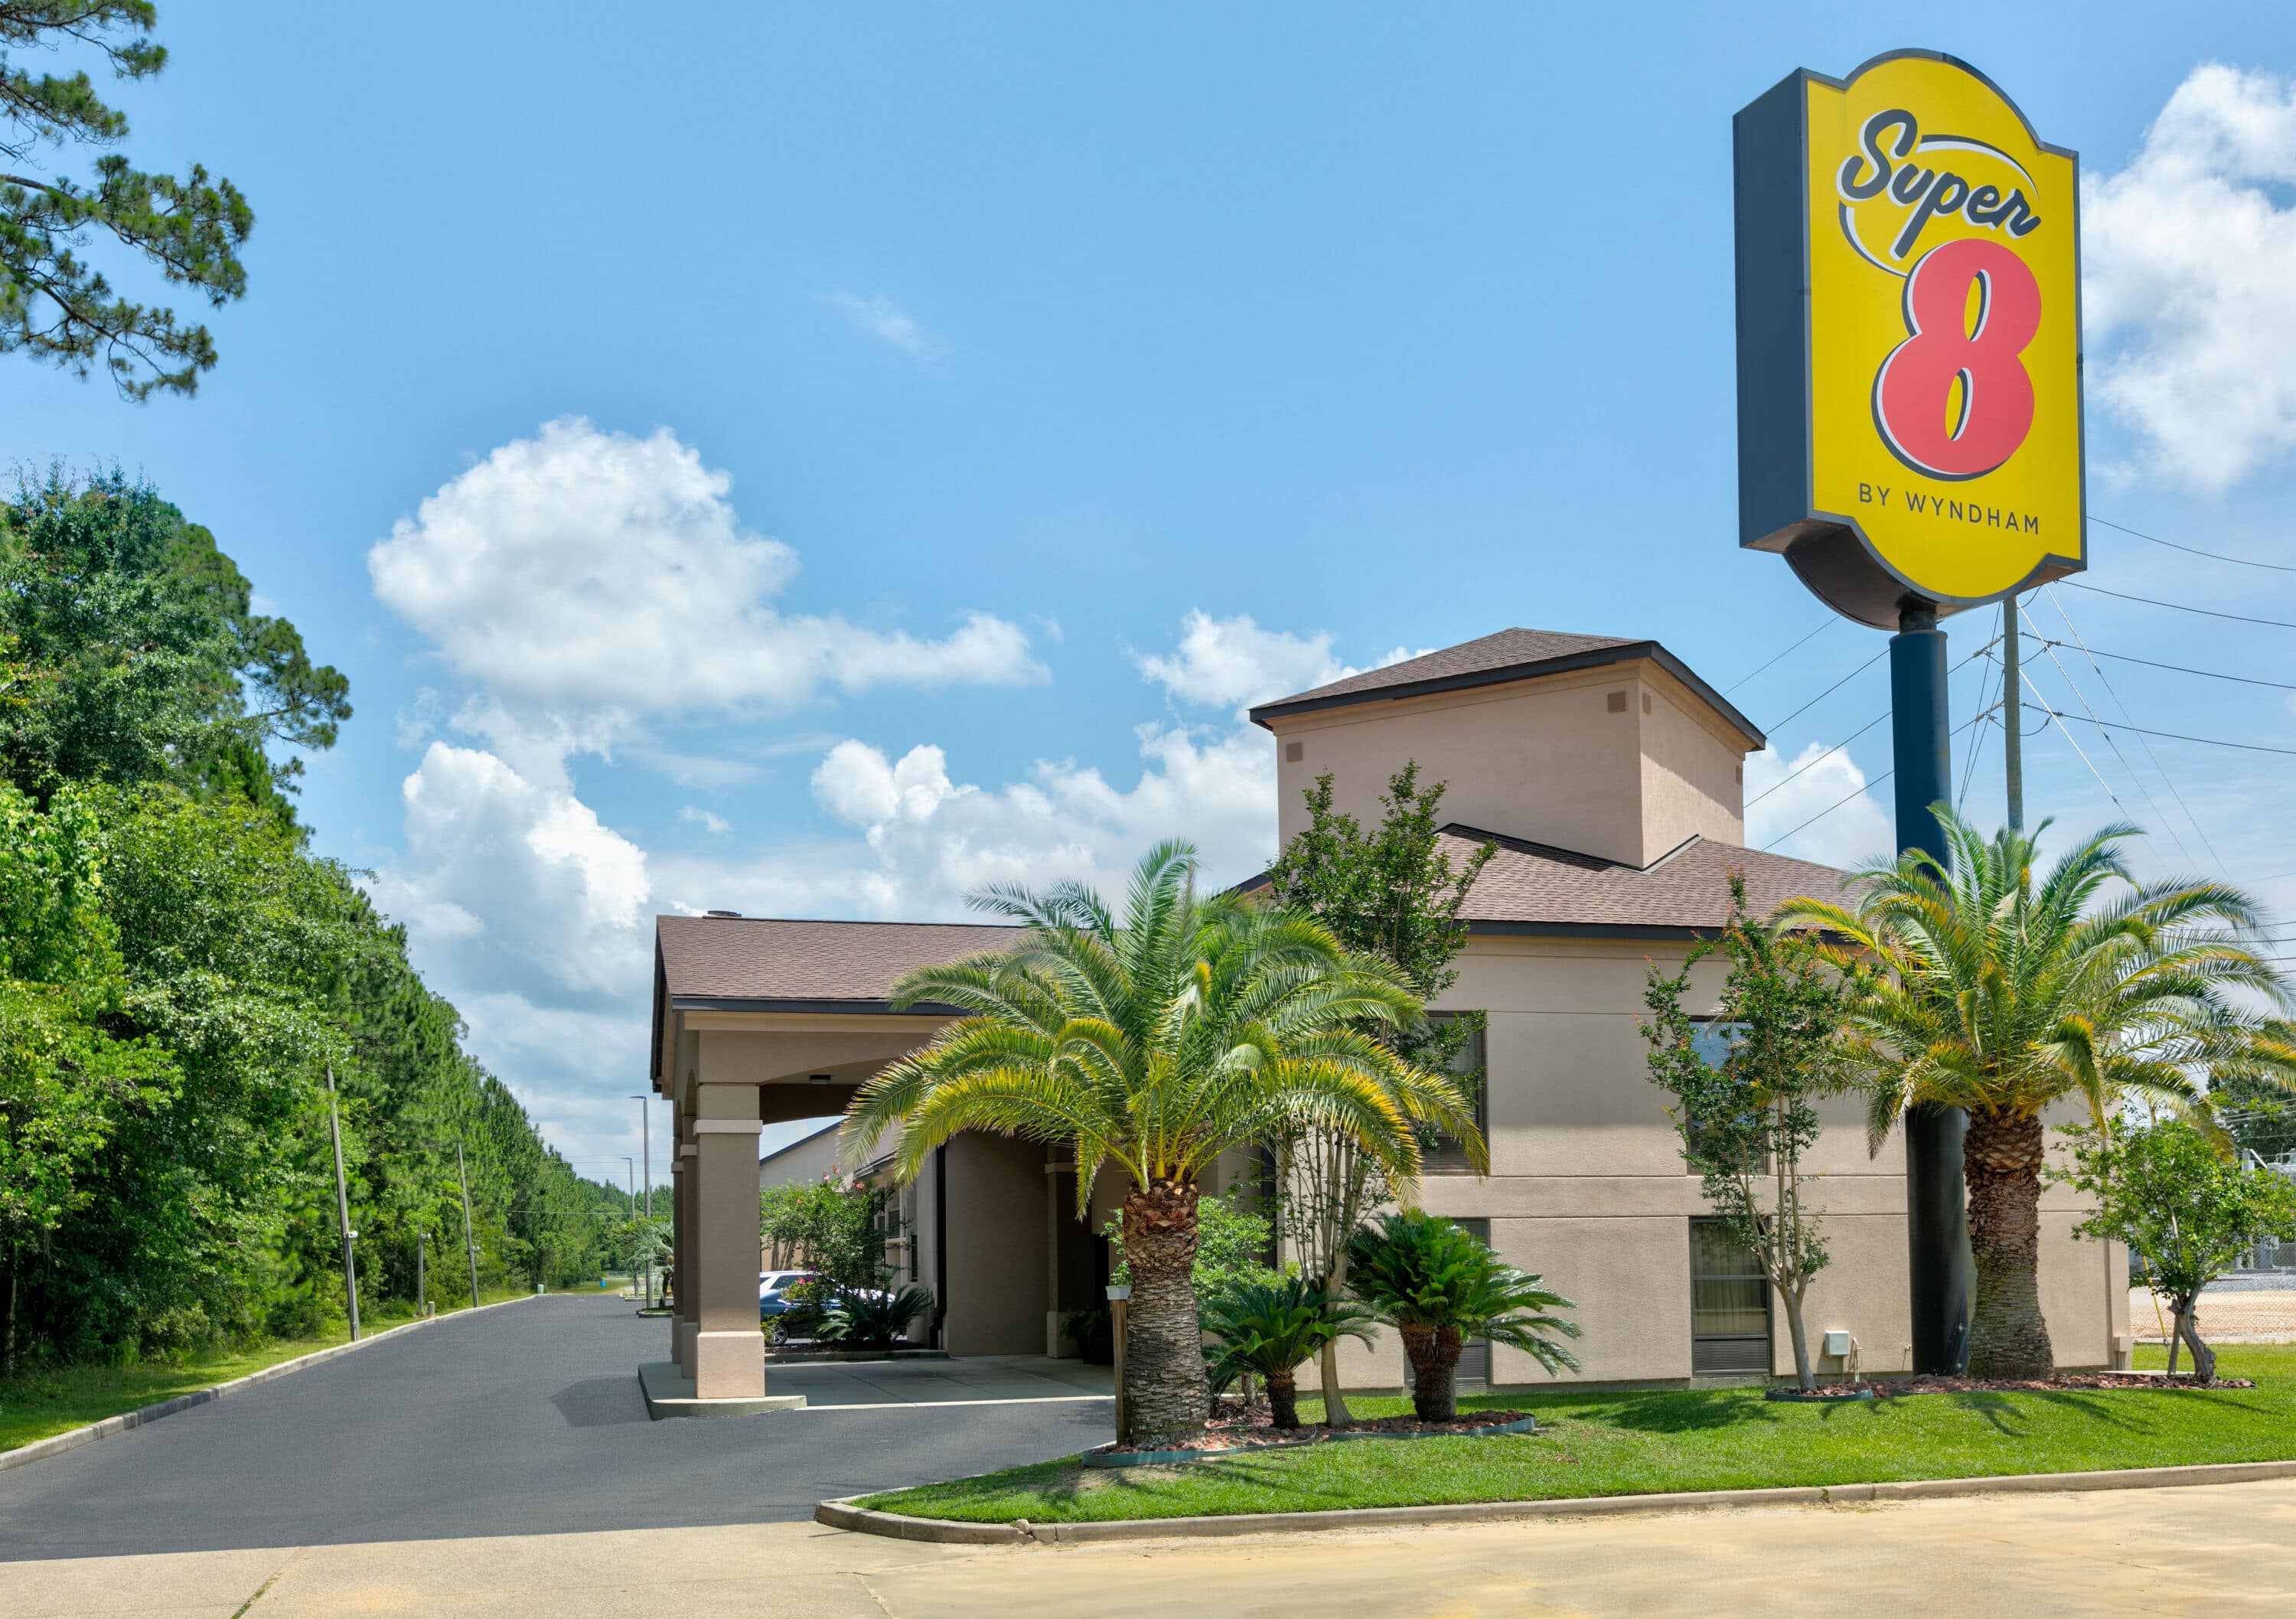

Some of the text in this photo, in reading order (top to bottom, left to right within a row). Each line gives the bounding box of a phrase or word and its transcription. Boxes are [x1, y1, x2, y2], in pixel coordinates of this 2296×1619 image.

[1836, 108, 2041, 260] Super
[1870, 237, 2042, 482] 8
[1859, 483, 2040, 535] BY WYNDHAM
